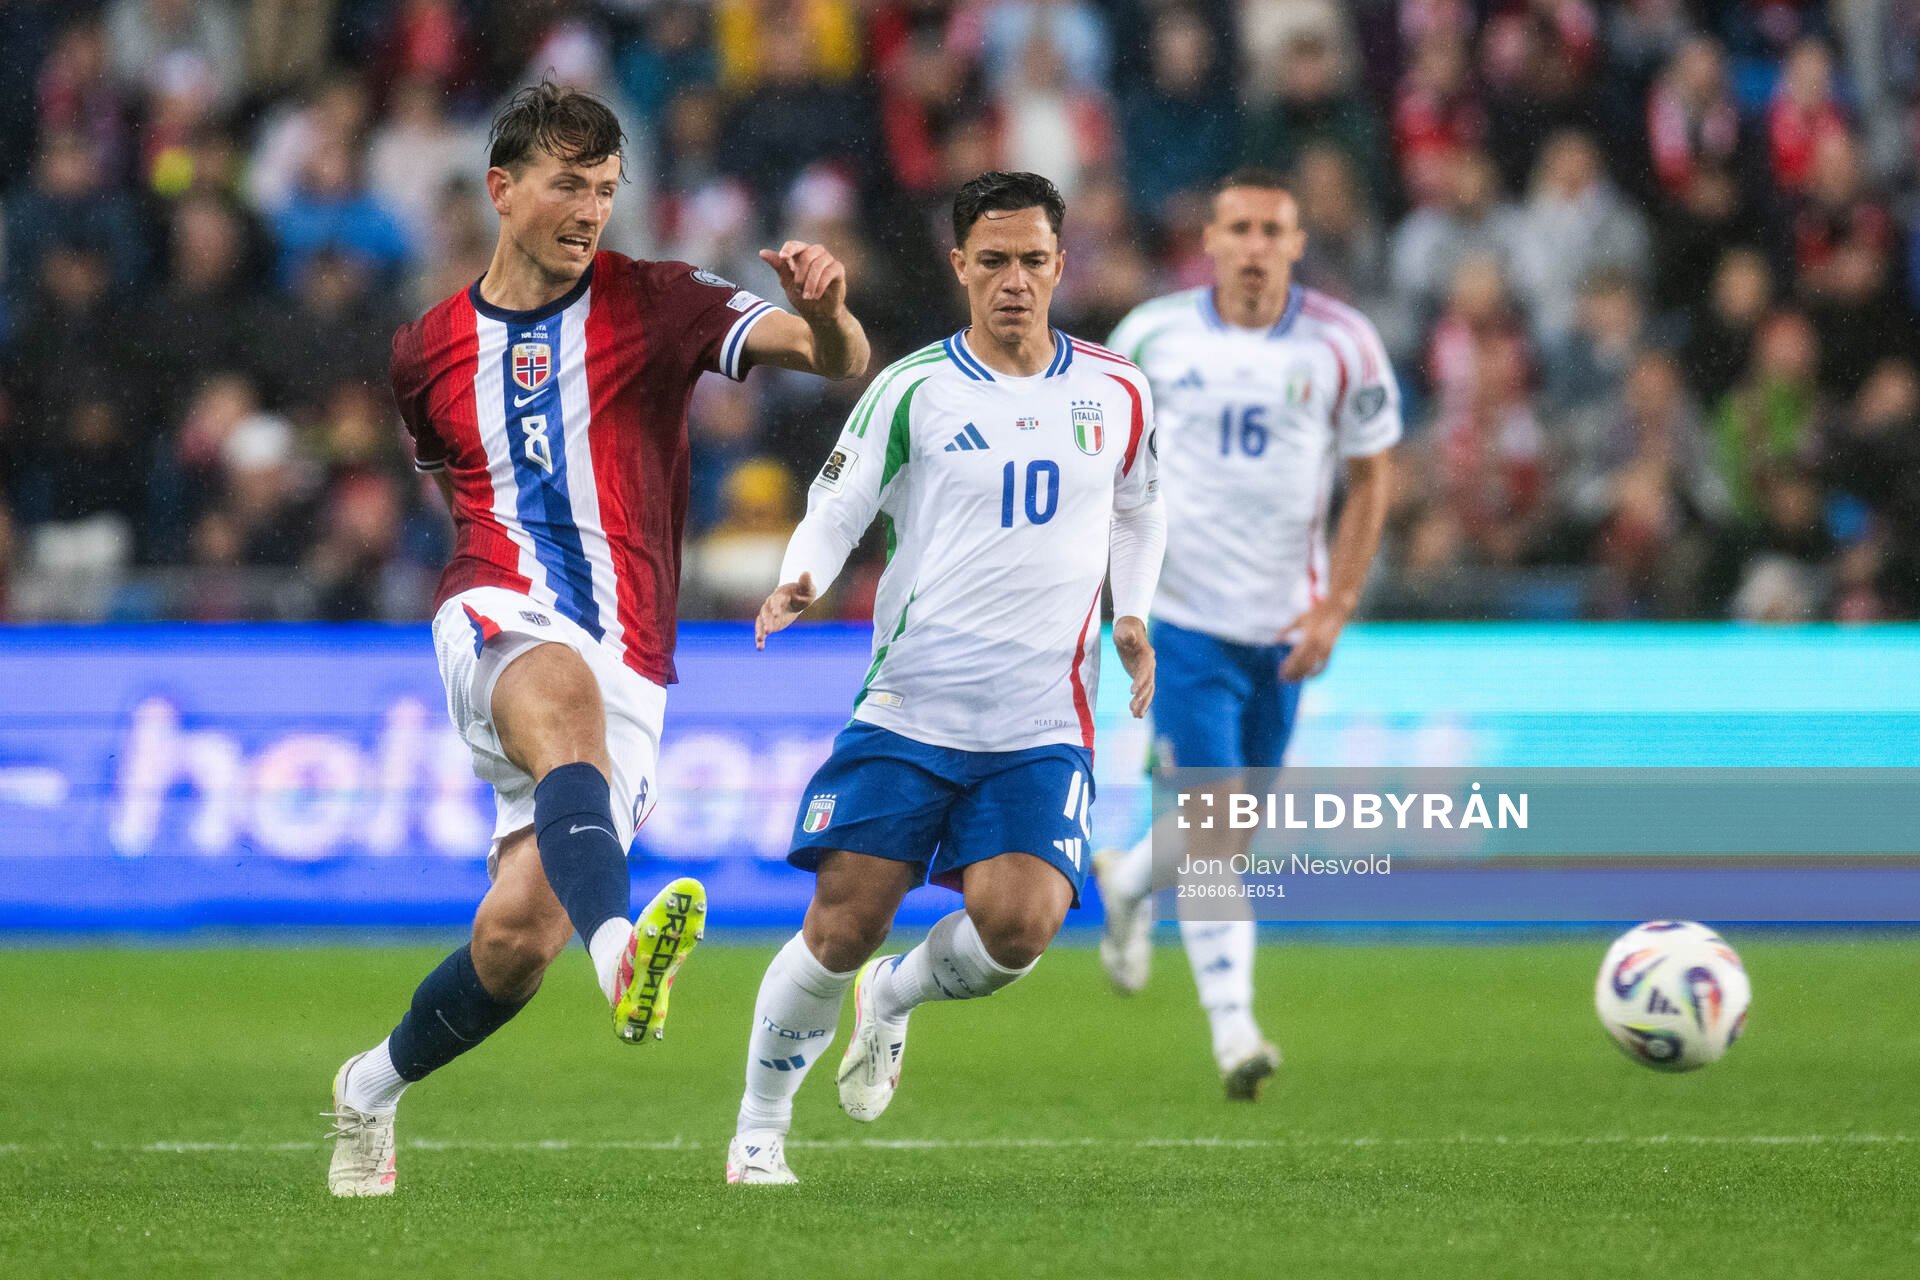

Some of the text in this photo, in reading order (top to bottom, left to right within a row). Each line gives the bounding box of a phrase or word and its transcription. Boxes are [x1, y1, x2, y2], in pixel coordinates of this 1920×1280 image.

[1074, 411, 1101, 422] ITALIA
[1220, 405, 1269, 459] 16
[521, 414, 553, 476] 8
[1001, 459, 1060, 528] 10
[811, 801, 832, 810] ITALIA
[628, 892, 692, 1042] PREDATOR
[762, 1015, 826, 1041] ITALIA
